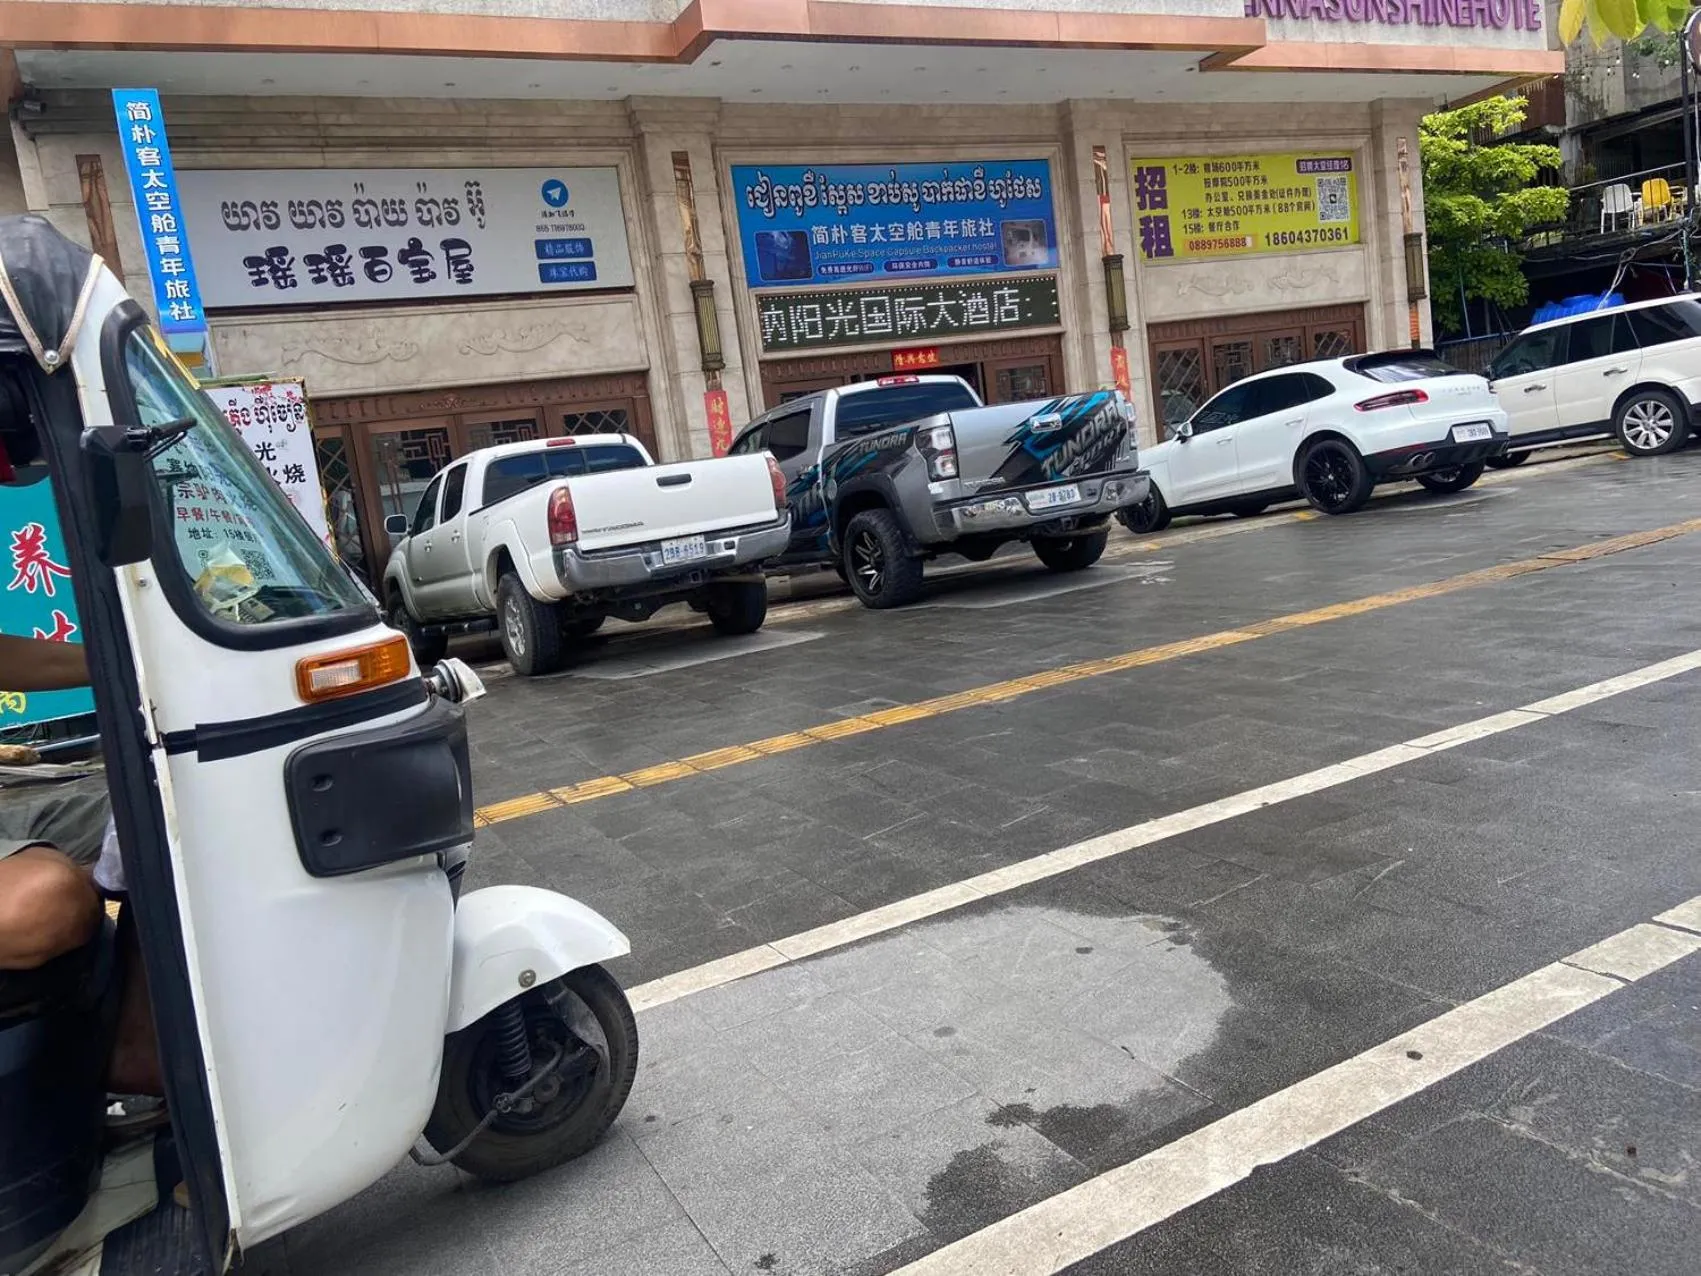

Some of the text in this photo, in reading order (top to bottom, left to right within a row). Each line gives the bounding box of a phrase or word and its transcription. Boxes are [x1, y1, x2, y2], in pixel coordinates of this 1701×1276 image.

[126, 101, 196, 321] 简朴客太空舱青年旅社
[1134, 166, 1174, 259] 招租
[812, 218, 995, 245] 简朴客太空舱青年旅社
[1264, 227, 1350, 247] 18604370361
[243, 237, 474, 289] 瑶瑶百宝屋
[859, 432, 908, 452] TUNDRA
